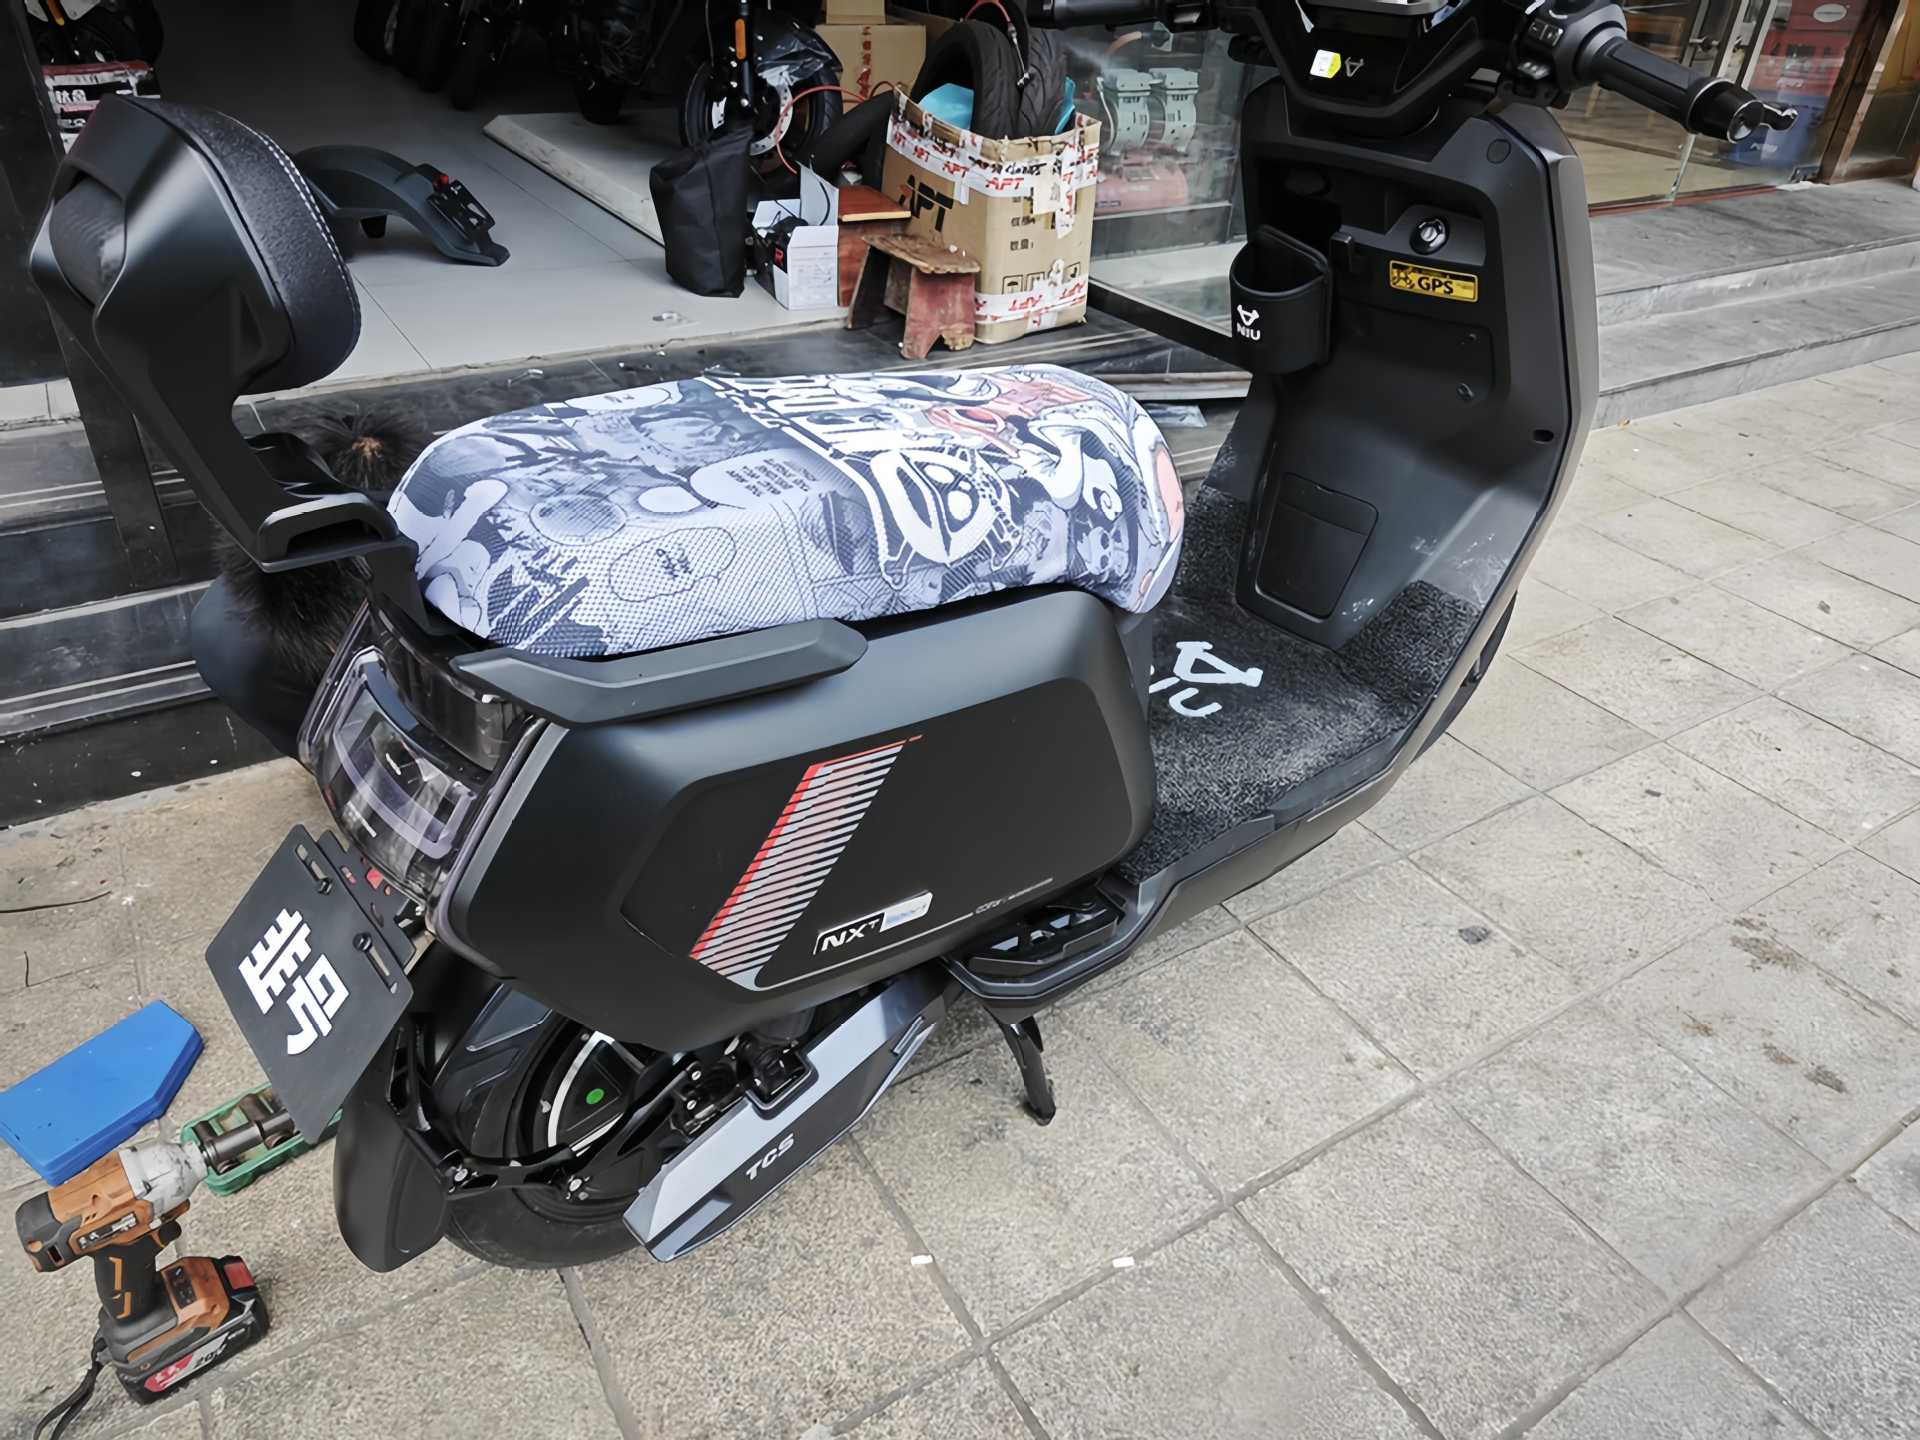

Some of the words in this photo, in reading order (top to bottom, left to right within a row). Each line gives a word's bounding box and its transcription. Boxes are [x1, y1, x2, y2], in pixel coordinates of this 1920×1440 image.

[1417, 275, 1454, 296] GPS
[1236, 321, 1261, 341] NIU
[745, 1132, 795, 1181] TCS
